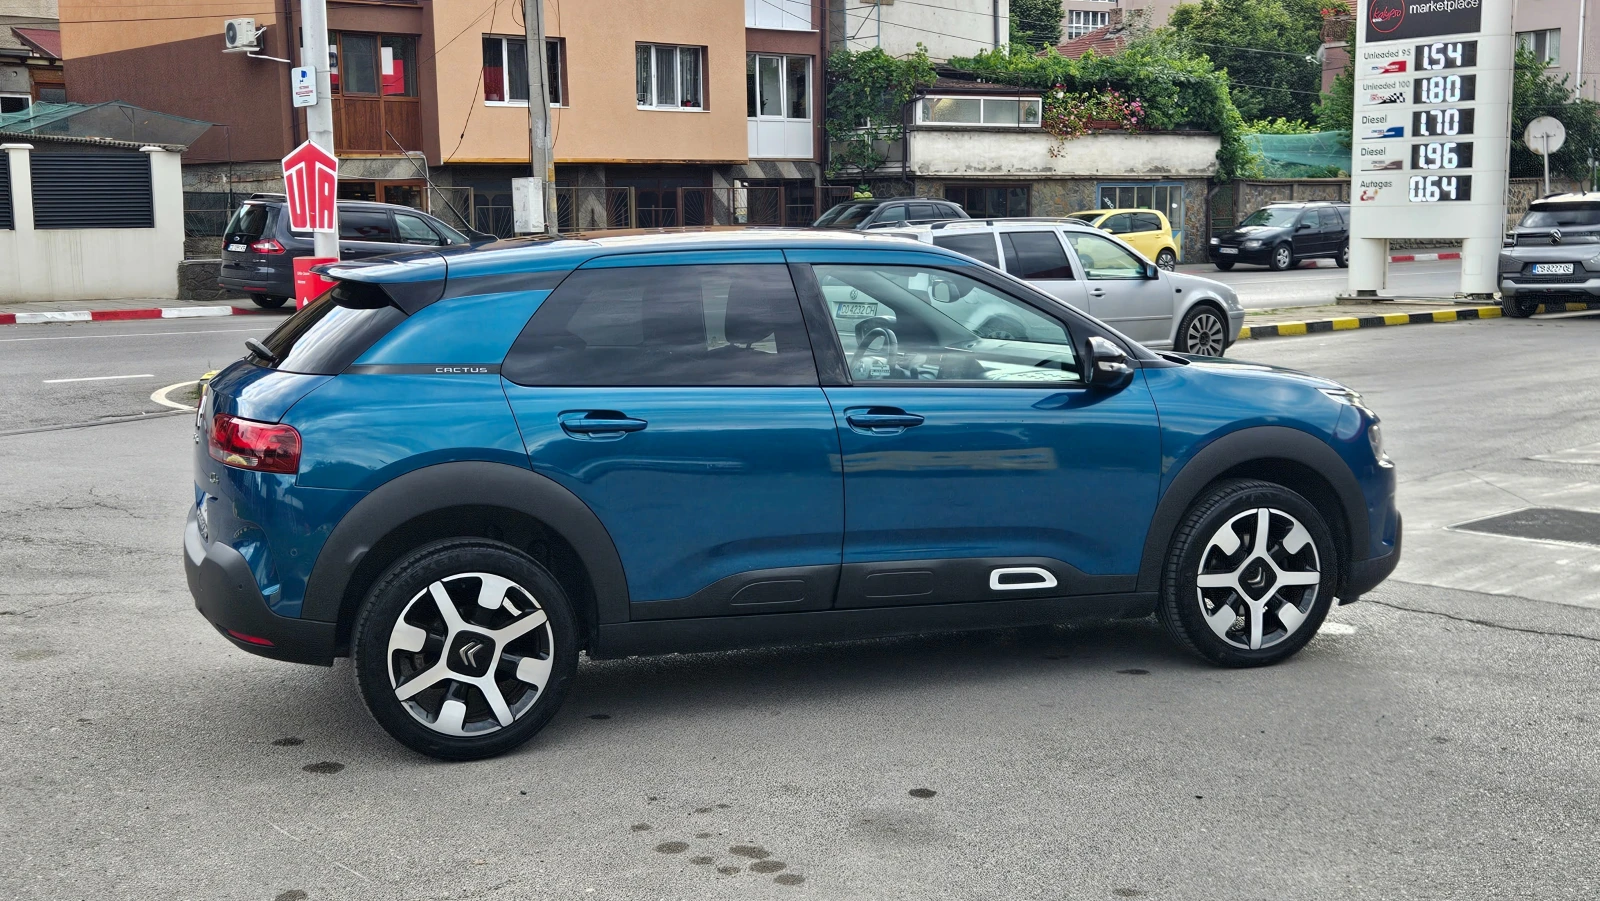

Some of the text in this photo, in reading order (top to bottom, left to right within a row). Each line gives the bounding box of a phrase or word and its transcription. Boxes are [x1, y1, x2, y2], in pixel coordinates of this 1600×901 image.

[1409, 0, 1479, 13] marketplace
[1363, 49, 1411, 60] Unleaded 95
[1362, 80, 1411, 91] Unleaded 100
[1361, 114, 1388, 125] Diesel
[1360, 146, 1386, 157] Diesel
[1360, 180, 1393, 190] Autogas
[850, 304, 865, 315] 4232
